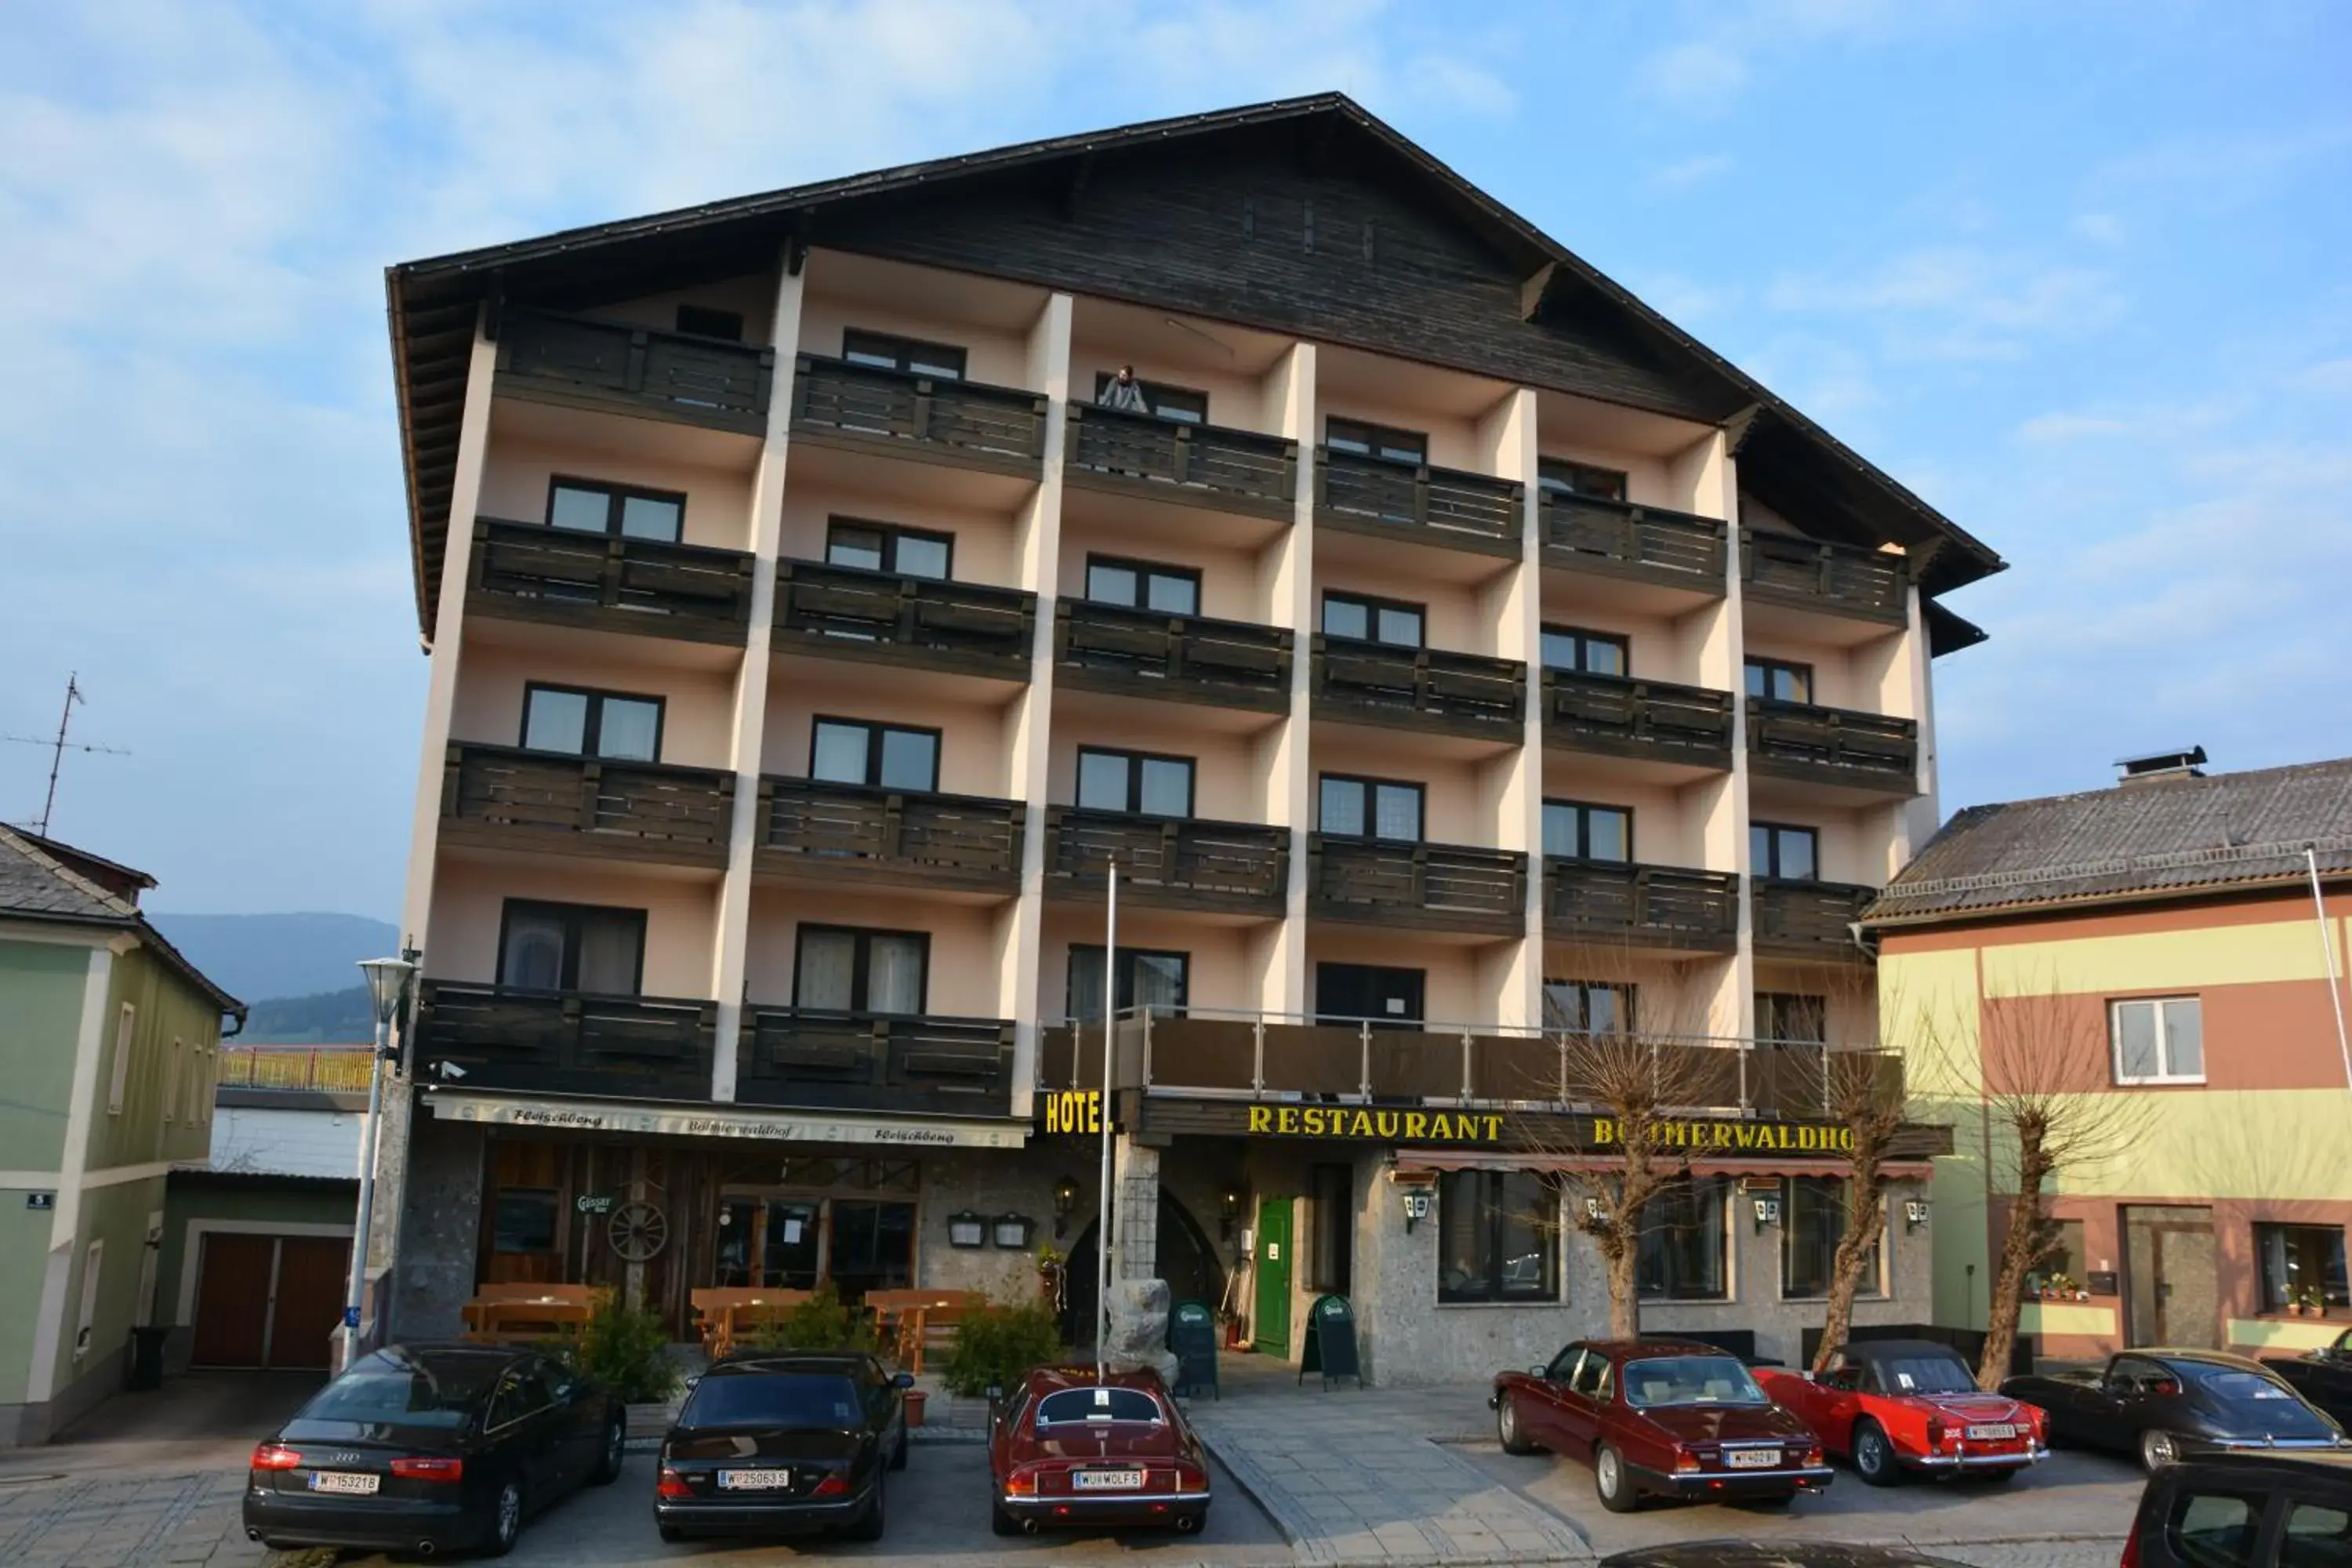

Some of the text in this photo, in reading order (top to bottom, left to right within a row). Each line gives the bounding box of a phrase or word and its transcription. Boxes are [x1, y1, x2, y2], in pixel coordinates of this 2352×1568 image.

[1046, 1091, 1114, 1133] HOTE
[1248, 1105, 1855, 1151] RESTAURANT BMERWALDHO
